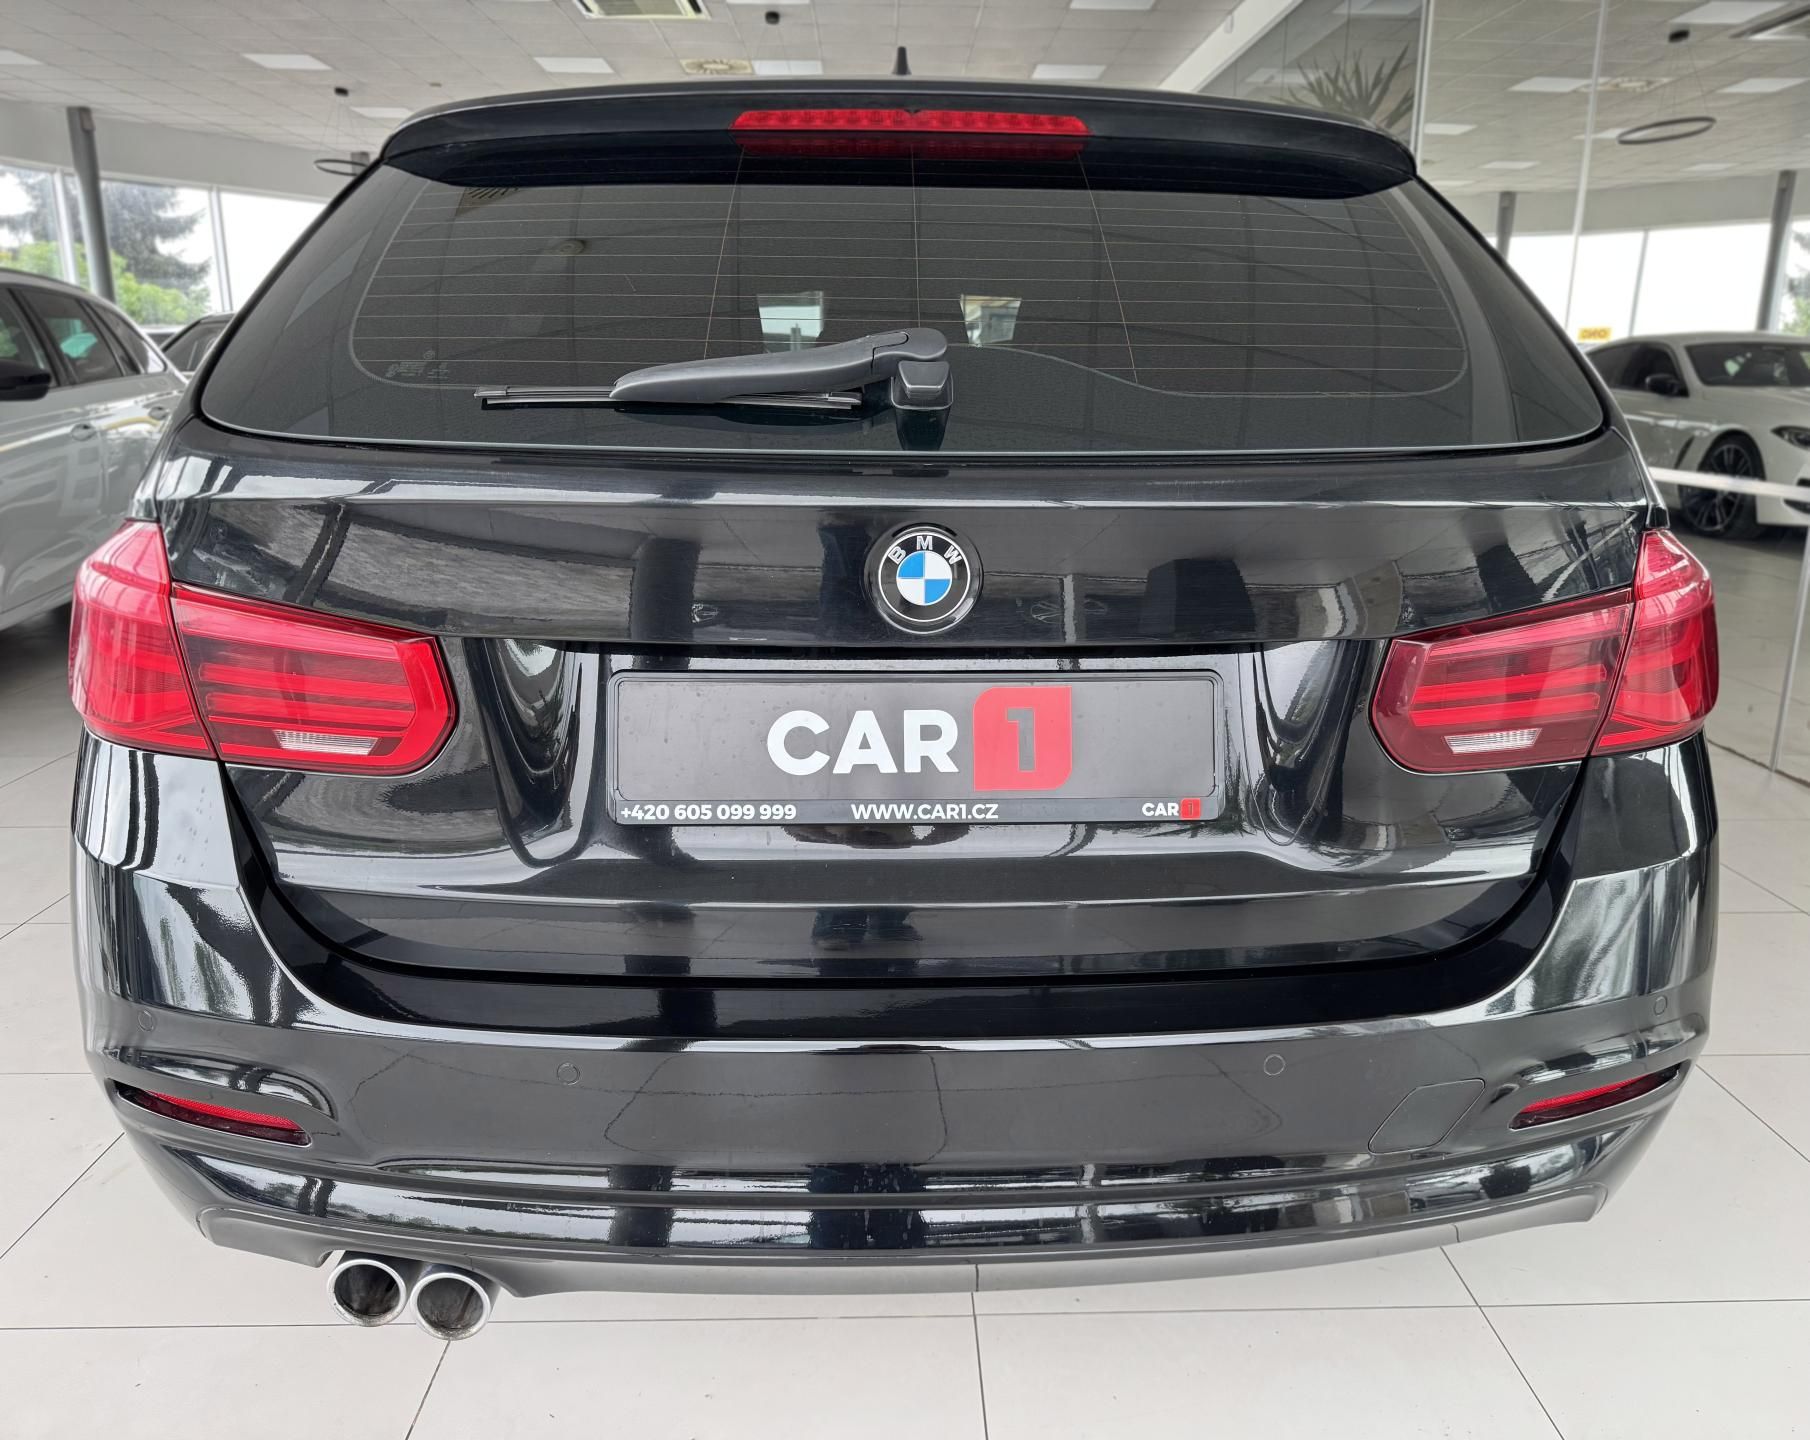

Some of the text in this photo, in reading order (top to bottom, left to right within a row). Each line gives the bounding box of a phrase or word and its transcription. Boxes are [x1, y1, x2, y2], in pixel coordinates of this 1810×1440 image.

[888, 536, 962, 565] BMW
[621, 804, 797, 820] +420 605 099 999
[850, 803, 999, 820] WWW.CAR1.CZ
